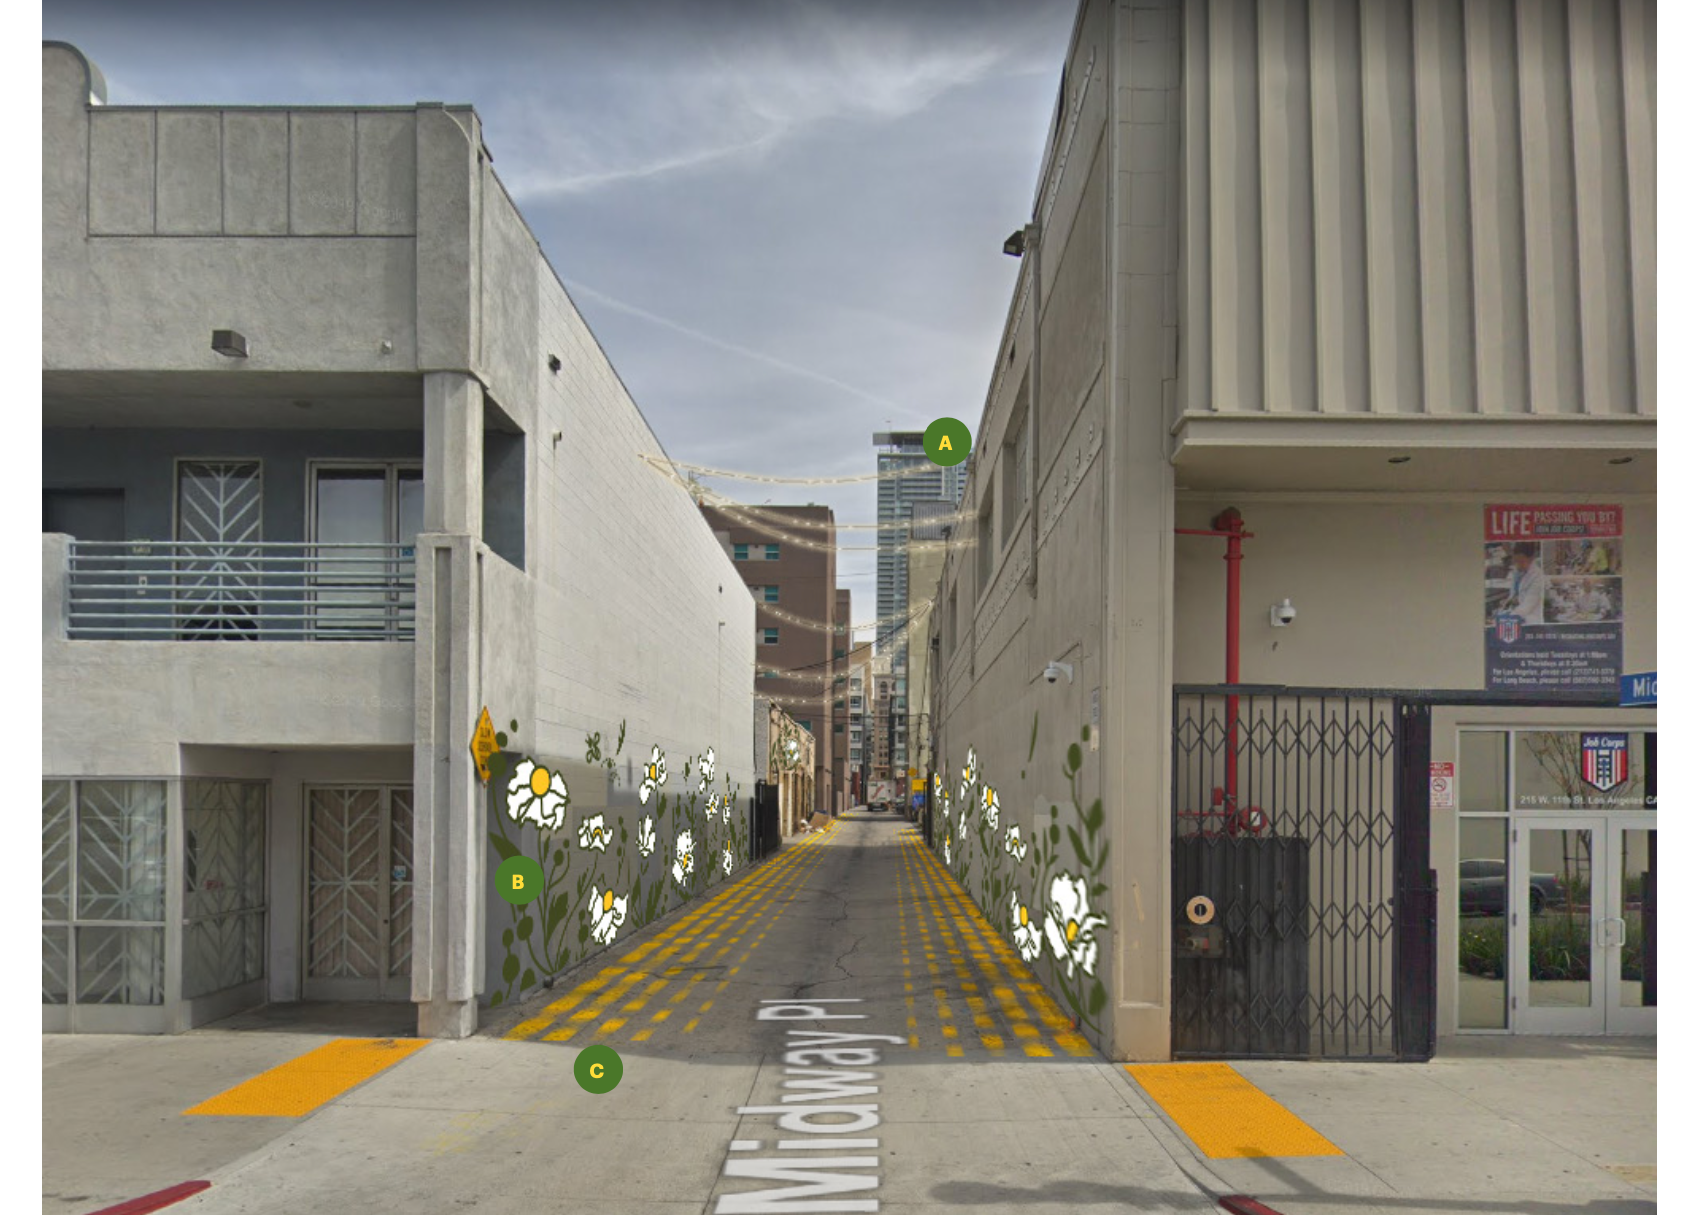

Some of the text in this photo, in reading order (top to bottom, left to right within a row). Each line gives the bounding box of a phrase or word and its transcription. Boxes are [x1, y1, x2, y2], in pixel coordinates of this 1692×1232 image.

[1492, 511, 1531, 535] LIFE
[1534, 511, 1574, 523] PASSING
[1576, 510, 1596, 523] YOU
[1584, 737, 1625, 749] Job Corps
[1520, 795, 1537, 804] 215
[1538, 795, 1549, 804] W.
[1588, 795, 1605, 804] Los
[1607, 795, 1643, 806] Angeles
